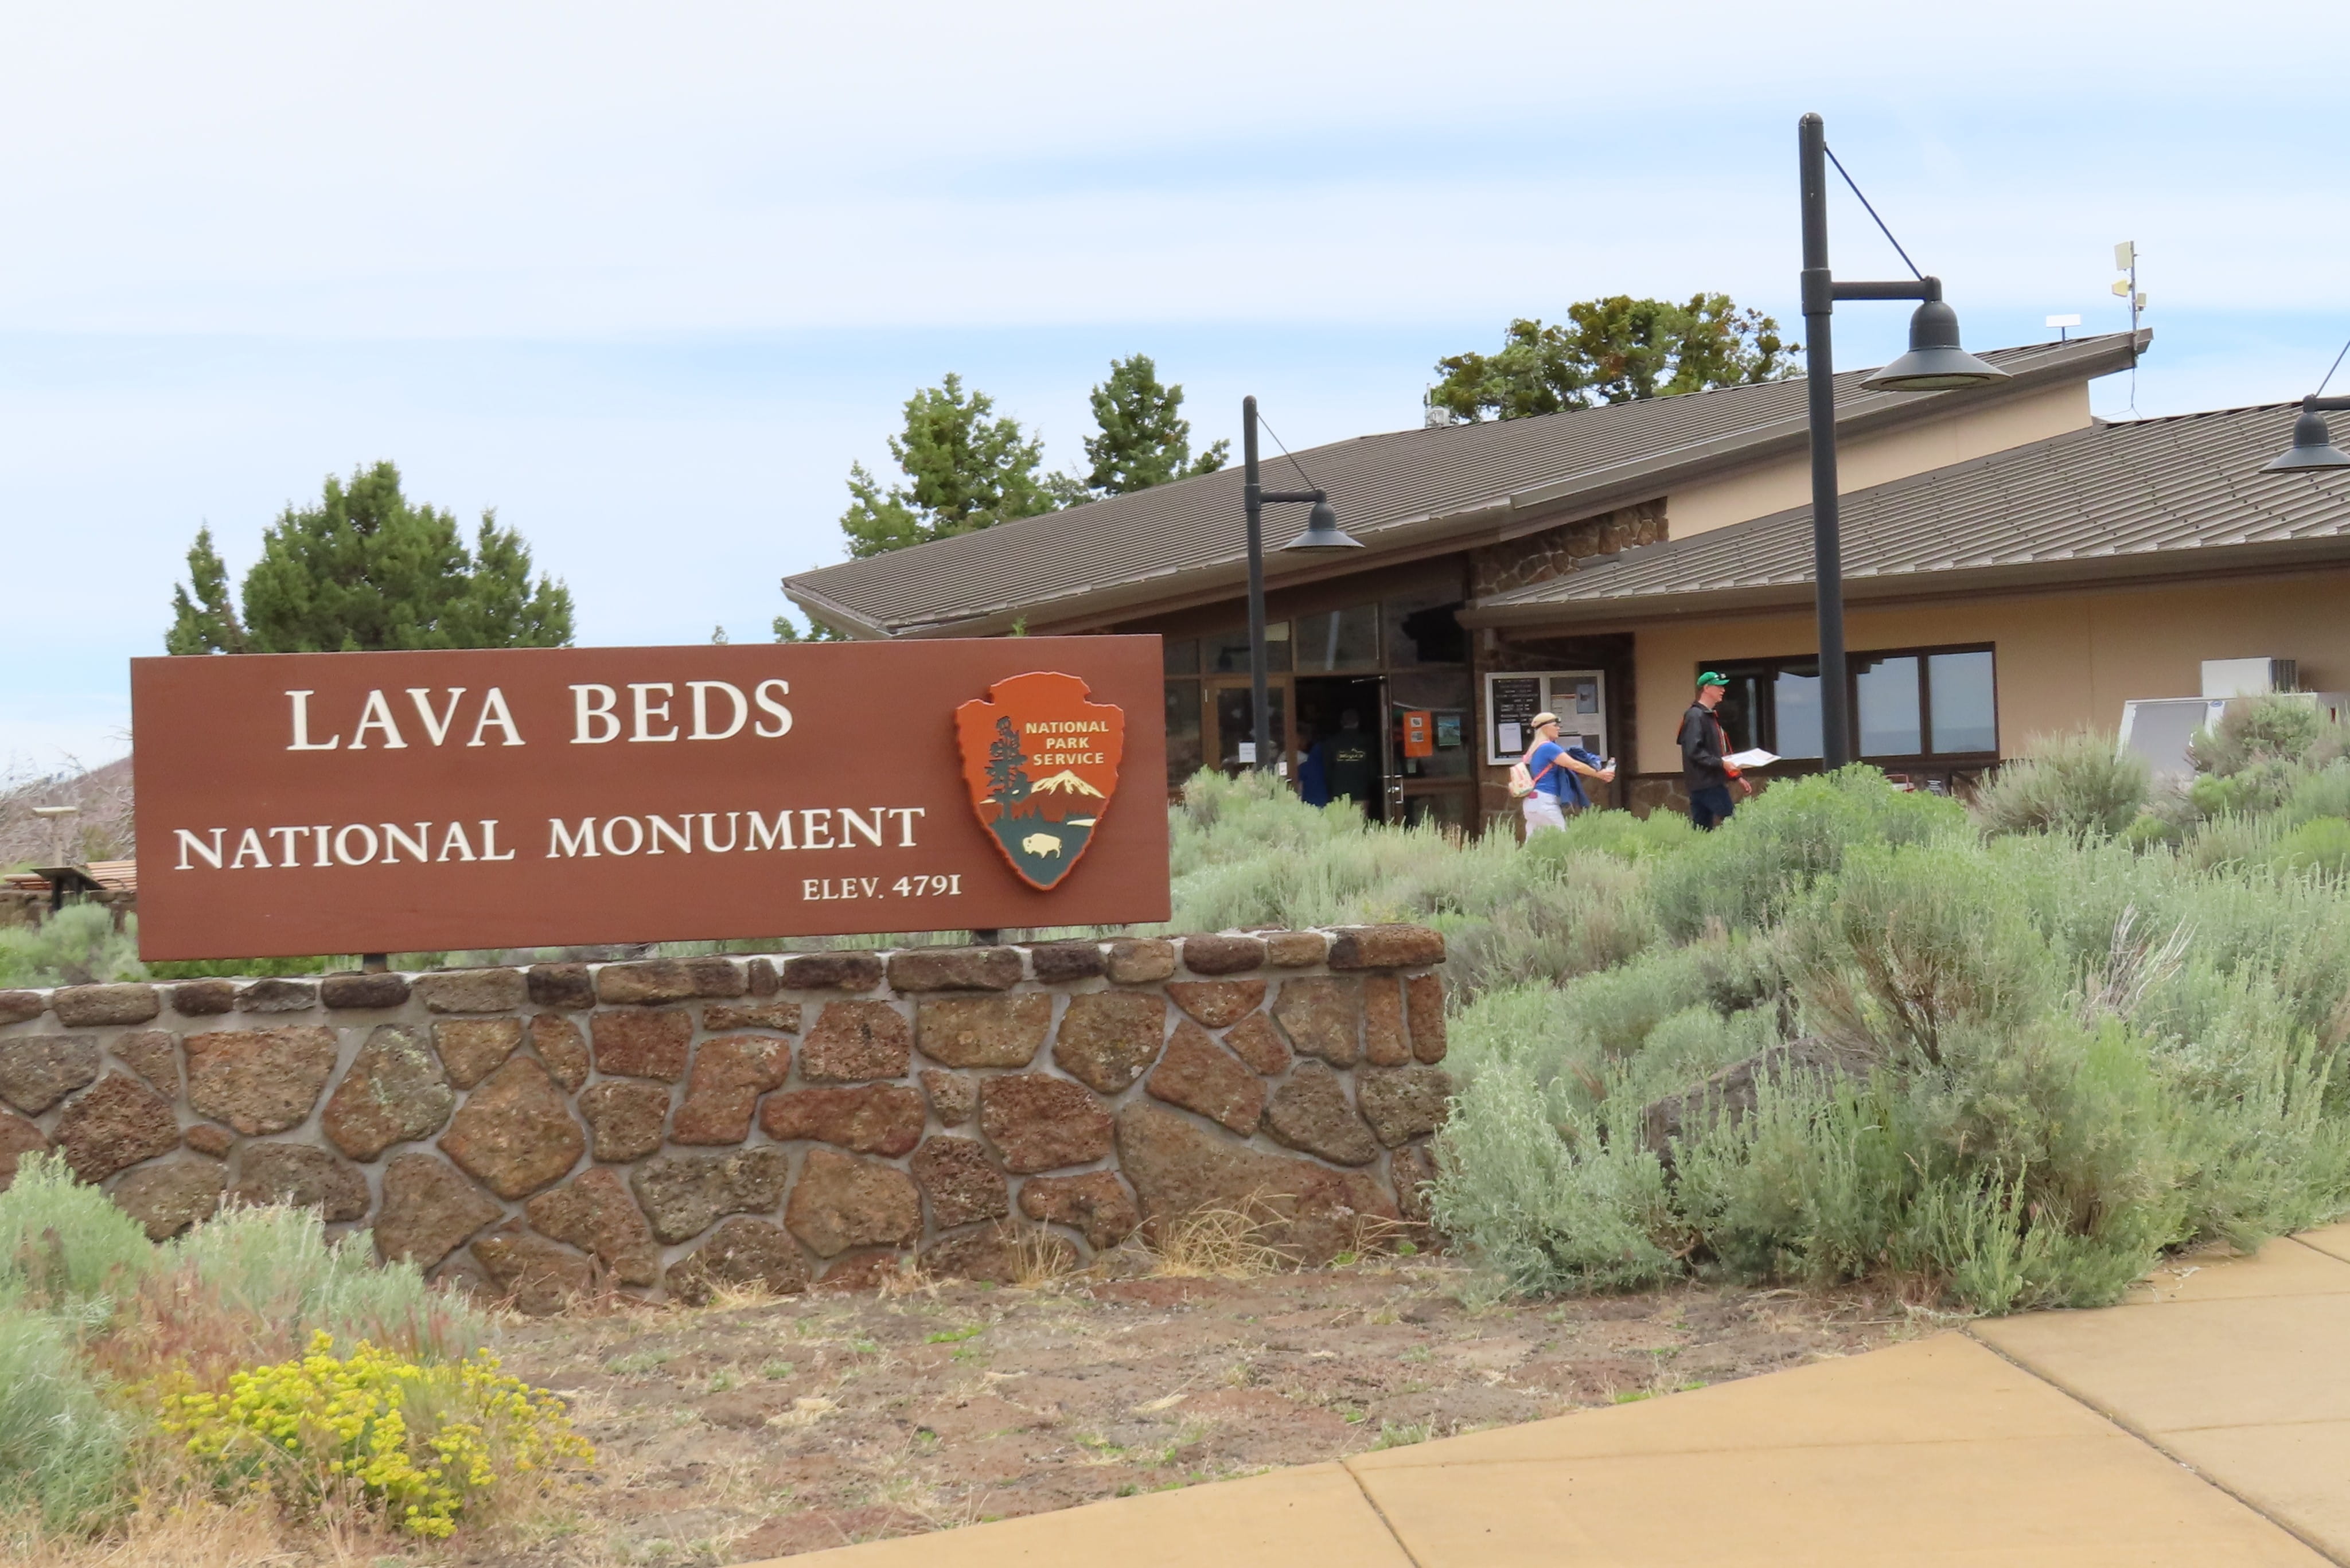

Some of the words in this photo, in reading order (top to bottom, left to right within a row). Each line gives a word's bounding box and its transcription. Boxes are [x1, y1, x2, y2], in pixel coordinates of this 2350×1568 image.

[284, 687, 527, 751] LAVA
[568, 678, 793, 744] BEDS
[1026, 721, 1109, 734] NATIONAL
[1046, 737, 1090, 749] PARK
[1033, 752, 1104, 766] SERVICE
[173, 819, 516, 871] NATIONAL
[545, 806, 926, 860] MONUMENT
[802, 877, 884, 900] ELEV.
